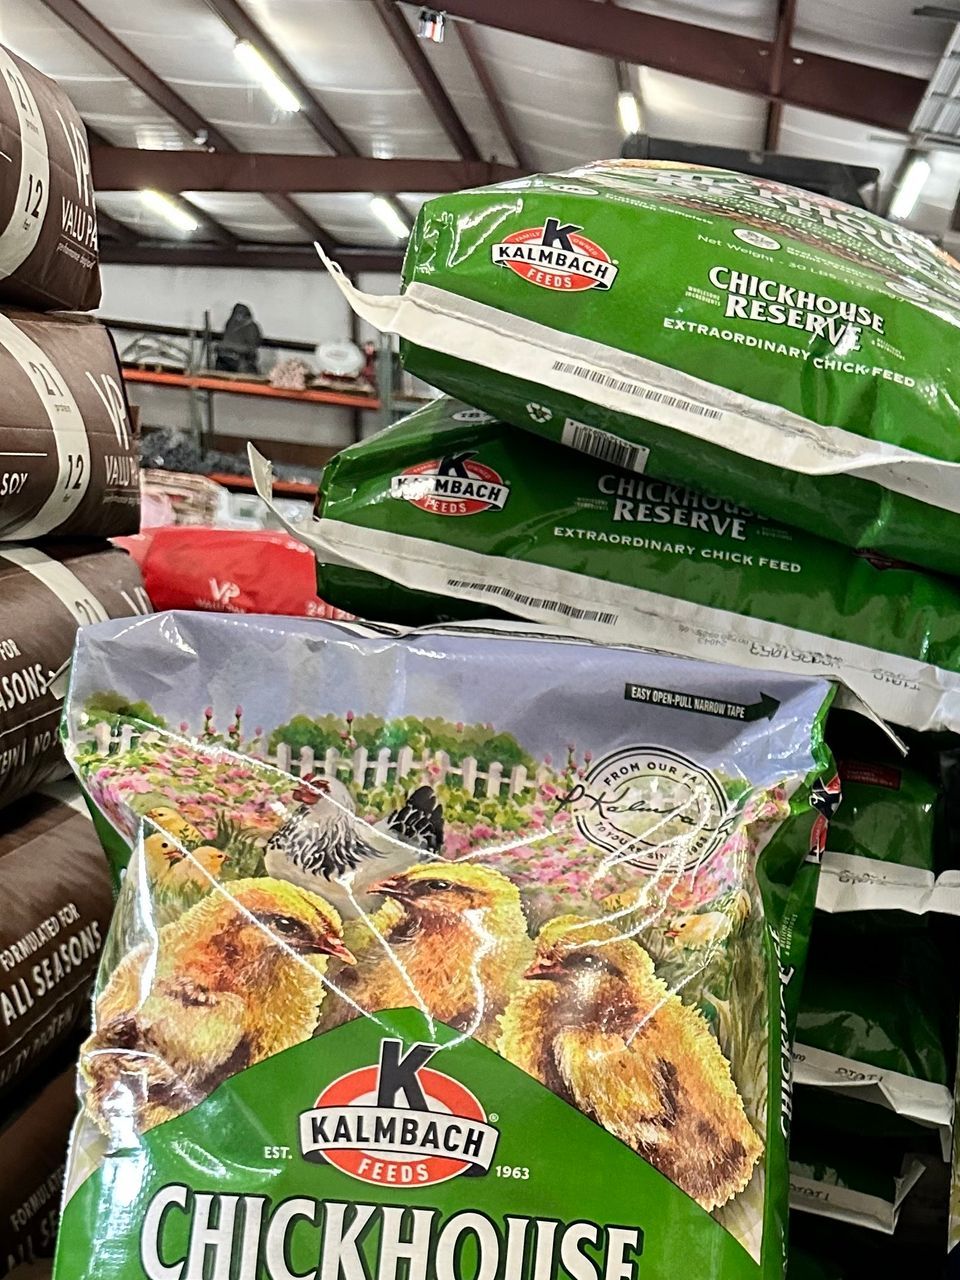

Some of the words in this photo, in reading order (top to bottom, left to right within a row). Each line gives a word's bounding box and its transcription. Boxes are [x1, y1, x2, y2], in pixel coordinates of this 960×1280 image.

[24, 173, 43, 219] 12
[62, 196, 85, 243] VALU
[499, 246, 610, 281] KALMBACH
[526, 268, 573, 289] FEEDS
[708, 265, 886, 335] CHICKHOUSE
[724, 294, 864, 356] RESERVE
[663, 317, 812, 362] EXTRAORDINARY
[813, 356, 870, 377] CHICK
[872, 366, 916, 389] FEED
[28, 361, 64, 397] 21
[85, 371, 130, 451] VP
[1, 473, 29, 496] SOY
[64, 454, 84, 490] 12
[612, 498, 748, 542] RESERVE
[553, 526, 696, 556] EXTRAORDINARY
[700, 548, 753, 567] CHICK
[758, 557, 802, 574] FEED
[208, 576, 241, 604] VP
[630, 687, 651, 700] EASY
[652, 690, 693, 708] OPEN-PULL
[693, 694, 726, 715] NARROW
[727, 702, 746, 719] TAPE
[603, 761, 641, 787] FROM
[646, 761, 678, 775] OUR
[0, 915, 60, 972] FORMULATED
[58, 902, 81, 927] FOR
[0, 978, 35, 1026] ALL
[32, 920, 103, 997] SEASONS
[311, 1115, 486, 1158] KALMBACH
[263, 1146, 293, 1160] EST.
[495, 1165, 531, 1180] 1963
[356, 1158, 430, 1182] FEEDS
